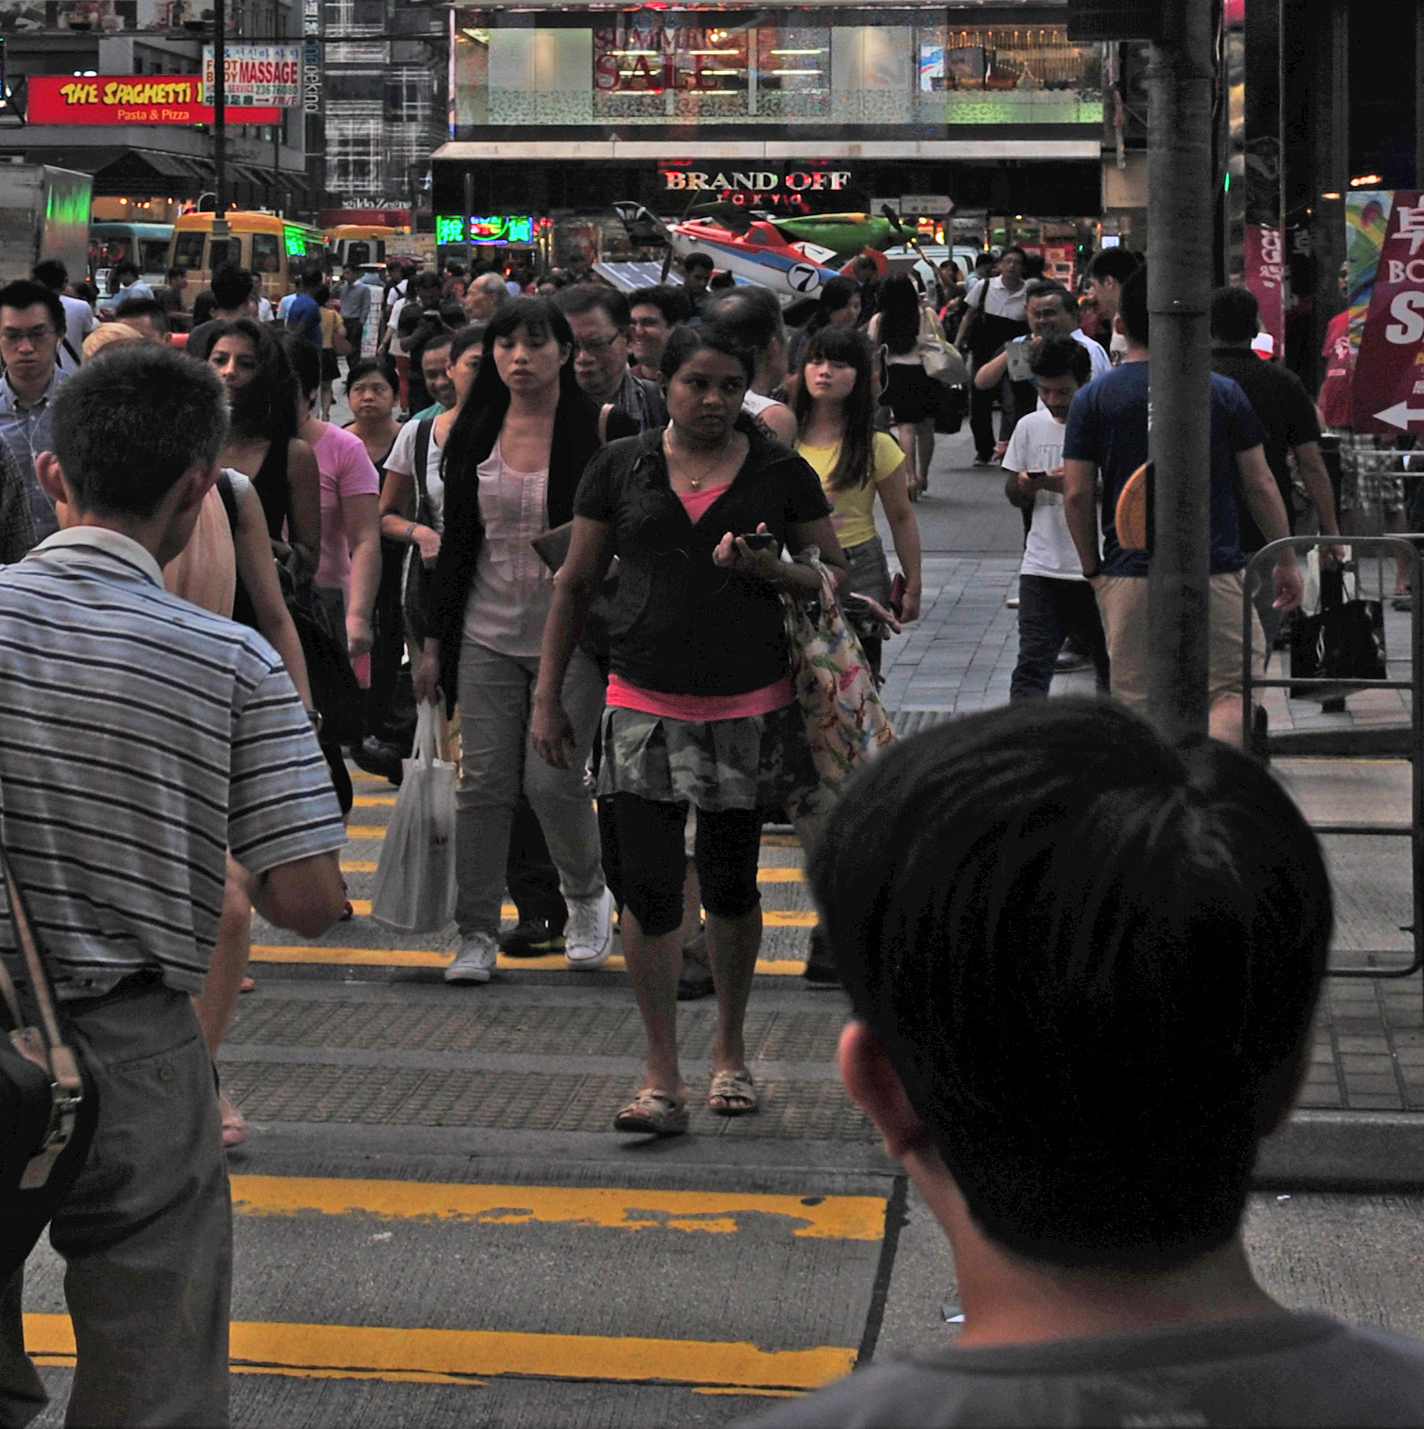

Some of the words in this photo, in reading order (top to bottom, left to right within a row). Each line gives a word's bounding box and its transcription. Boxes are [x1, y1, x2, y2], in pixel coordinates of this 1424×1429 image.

[206, 60, 238, 71] FOT
[239, 61, 298, 83] MASSAGE
[59, 83, 99, 104] THE
[117, 109, 147, 120] Pasta
[149, 110, 159, 120] &
[161, 109, 190, 120] Pizza
[664, 171, 779, 190] BRAND
[785, 171, 852, 190] OFF
[716, 193, 802, 205] TOKYO
[794, 266, 816, 292] 7
